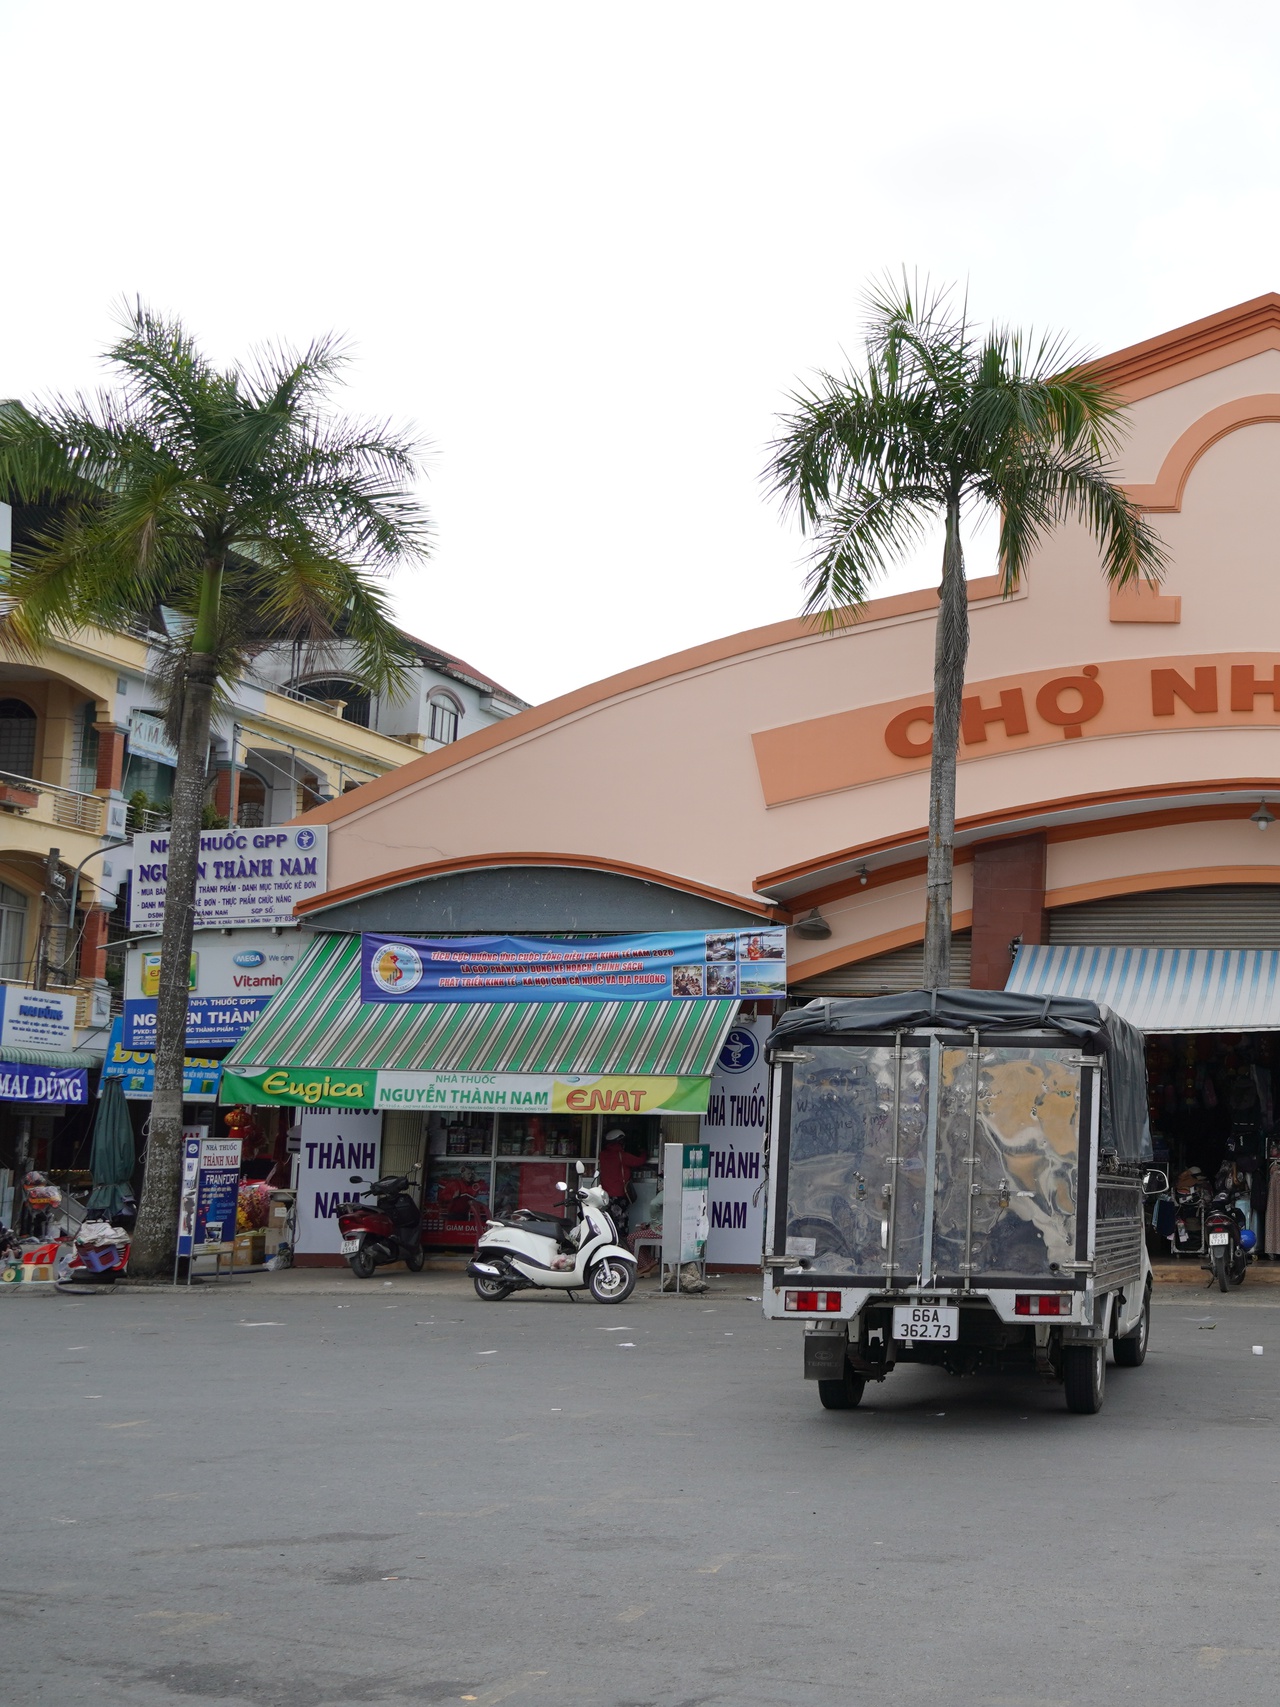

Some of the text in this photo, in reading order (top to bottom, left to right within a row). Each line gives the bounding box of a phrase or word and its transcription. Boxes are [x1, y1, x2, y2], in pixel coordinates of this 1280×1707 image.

[884, 664, 1105, 758] CHỢ
[253, 834, 288, 849] GPP
[213, 855, 274, 879] THÀNH
[280, 857, 317, 876] NAM
[431, 951, 451, 960] TÍCH
[584, 952, 598, 960] TRA
[600, 951, 620, 959] KINH
[595, 962, 620, 972] CHÍNH
[621, 961, 643, 971] SÁCH
[233, 974, 283, 987] Vitamin
[485, 977, 505, 986] KINH
[191, 998, 208, 1007] NHÀ
[210, 996, 238, 1006] THUỐC
[0, 1071, 83, 1101] MAI DŨNG
[435, 1073, 496, 1084] NHÀ THUỐC
[262, 1071, 364, 1104] Eugica
[379, 1083, 549, 1105] NGUYỄN THÀNH NAM
[566, 1089, 647, 1112] ENAT
[704, 1086, 726, 1126] NHÀ
[729, 1083, 765, 1127] THUỐC
[206, 1142, 237, 1151] NHÀ THUỐC
[306, 1135, 376, 1169] THÀNH
[203, 1153, 239, 1166] THÀNH NAM
[707, 1144, 759, 1179] THÀNH
[205, 1173, 239, 1185] FRANFORT
[711, 1201, 747, 1229] NAM
[912, 1308, 940, 1323] 66A
[900, 1323, 951, 1339] 362.73
